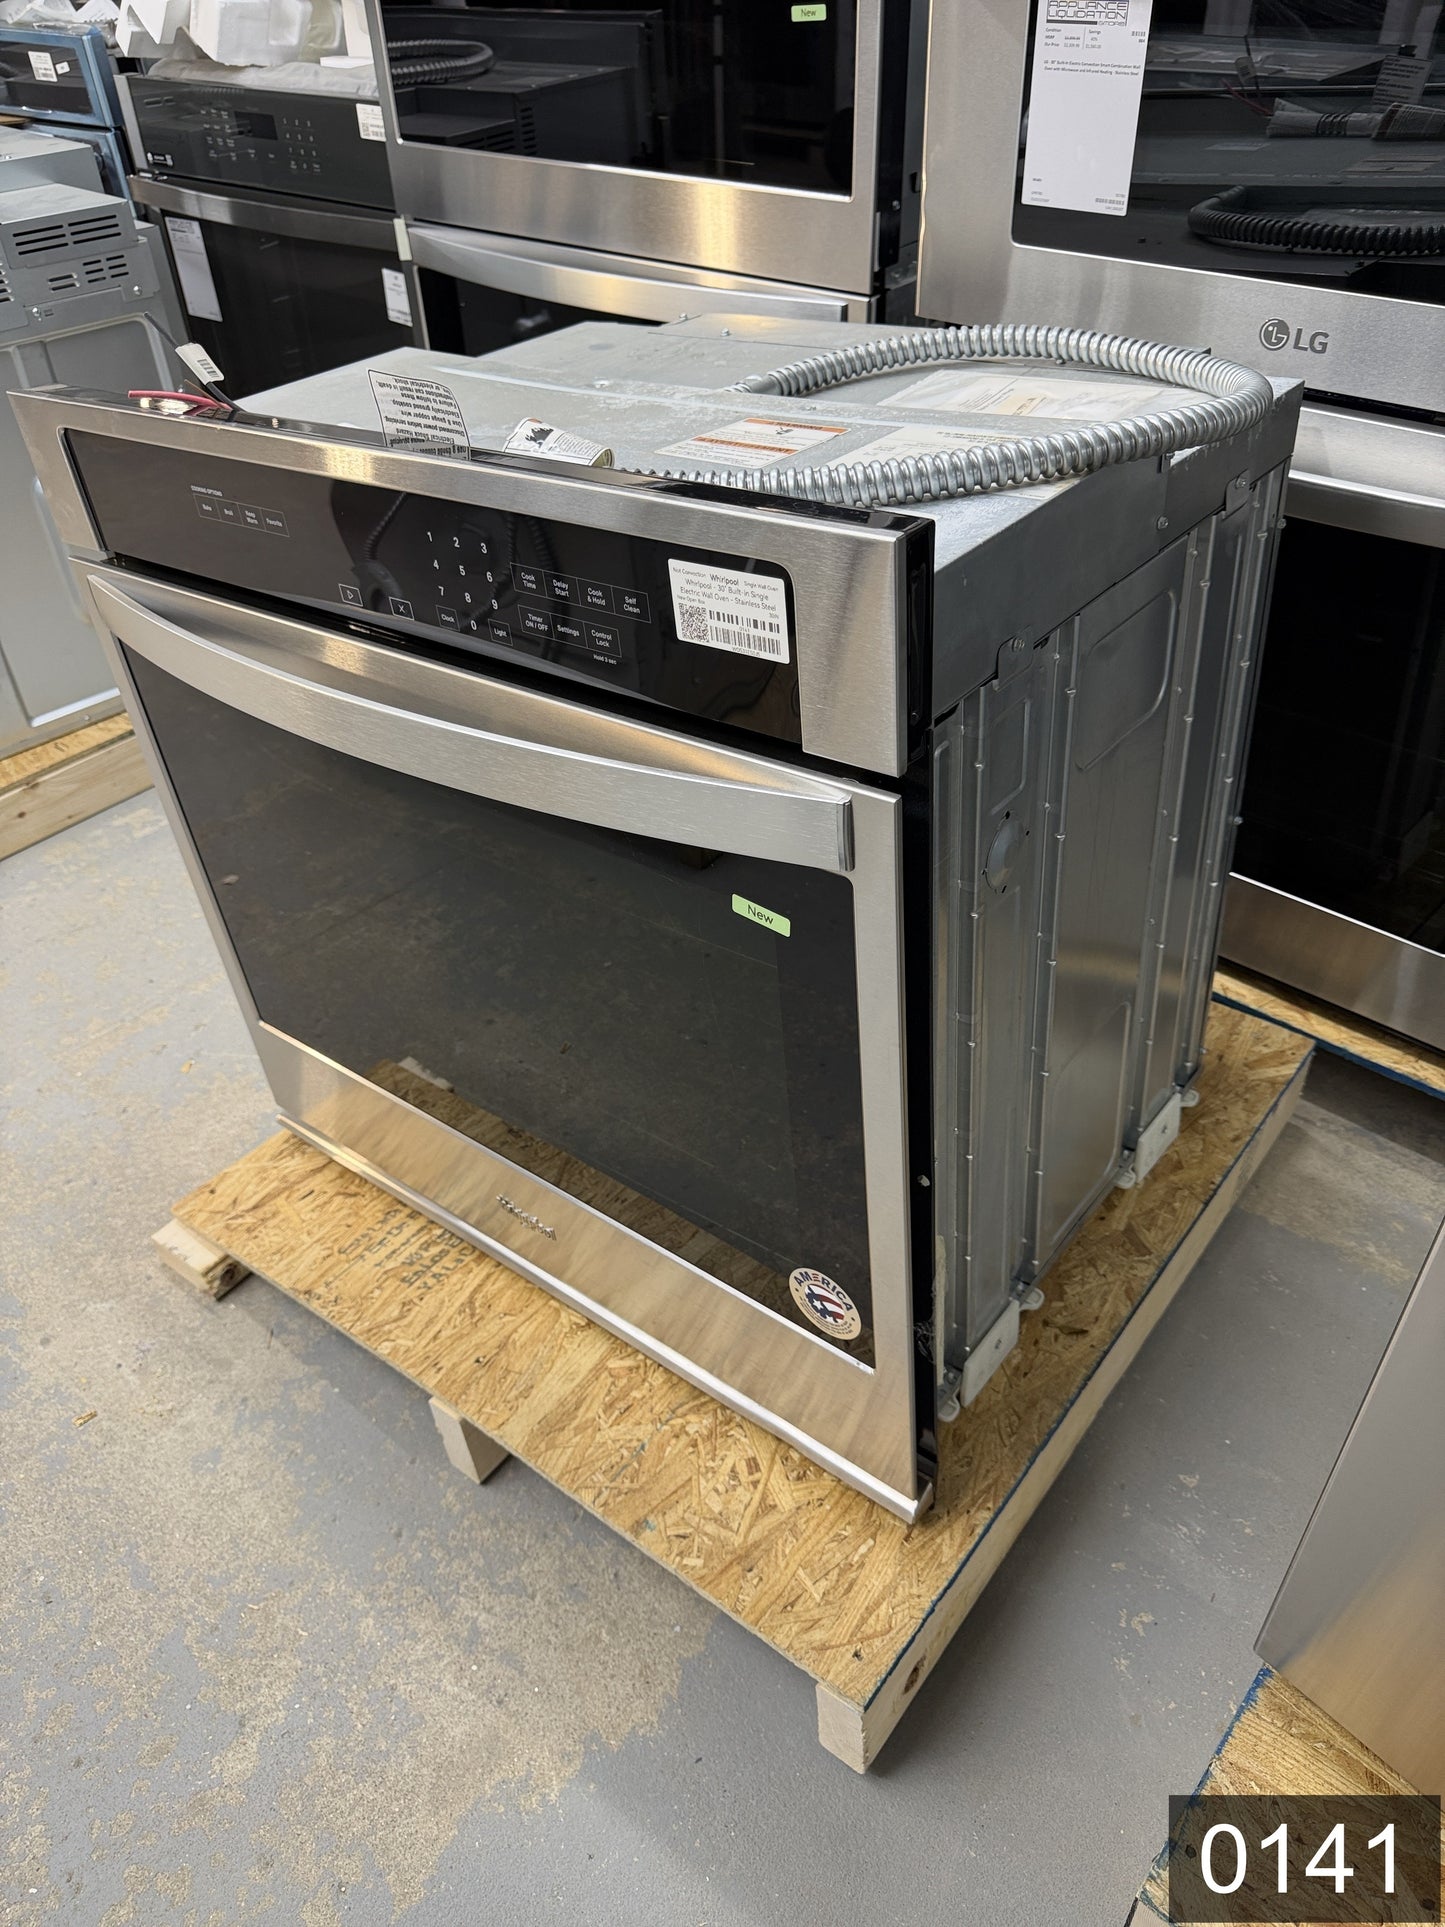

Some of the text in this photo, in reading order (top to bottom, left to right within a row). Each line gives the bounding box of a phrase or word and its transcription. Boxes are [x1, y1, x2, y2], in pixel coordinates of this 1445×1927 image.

[1049, 1, 1127, 10] APPLIANCE
[800, 8, 816, 17] New
[1048, 9, 1127, 20] LIQUIDATION
[1293, 327, 1330, 354] LG
[427, 531, 433, 542] 1
[453, 537, 460, 548] 2
[480, 543, 488, 554] 3
[433, 559, 439, 570] 4
[459, 566, 465, 576] 5
[486, 571, 493, 582] 6
[521, 572, 536, 582] Cook
[710, 573, 739, 586] Whirlpool
[523, 580, 537, 590] Time
[552, 579, 569, 590] Delay
[685, 578, 712, 590] Whirlpool
[751, 591, 769, 601] Single
[438, 585, 444, 596] 7
[555, 587, 569, 598] Start
[587, 587, 603, 597] Cook
[465, 592, 472, 603] 8
[592, 596, 606, 607] Hold
[624, 596, 637, 604] Self
[680, 587, 700, 596] Electric
[702, 591, 713, 600] Wall
[735, 598, 760, 609] Stainless
[492, 599, 498, 610] 9
[623, 603, 640, 614] Clean
[441, 614, 455, 624] Clock
[527, 613, 544, 623] Timer
[470, 620, 477, 631] 0
[557, 624, 580, 637] Settings
[494, 627, 507, 638] Light
[591, 629, 612, 641] Control
[595, 638, 610, 648] Lock
[748, 904, 774, 924] New
[794, 1271, 853, 1311] AMERICA
